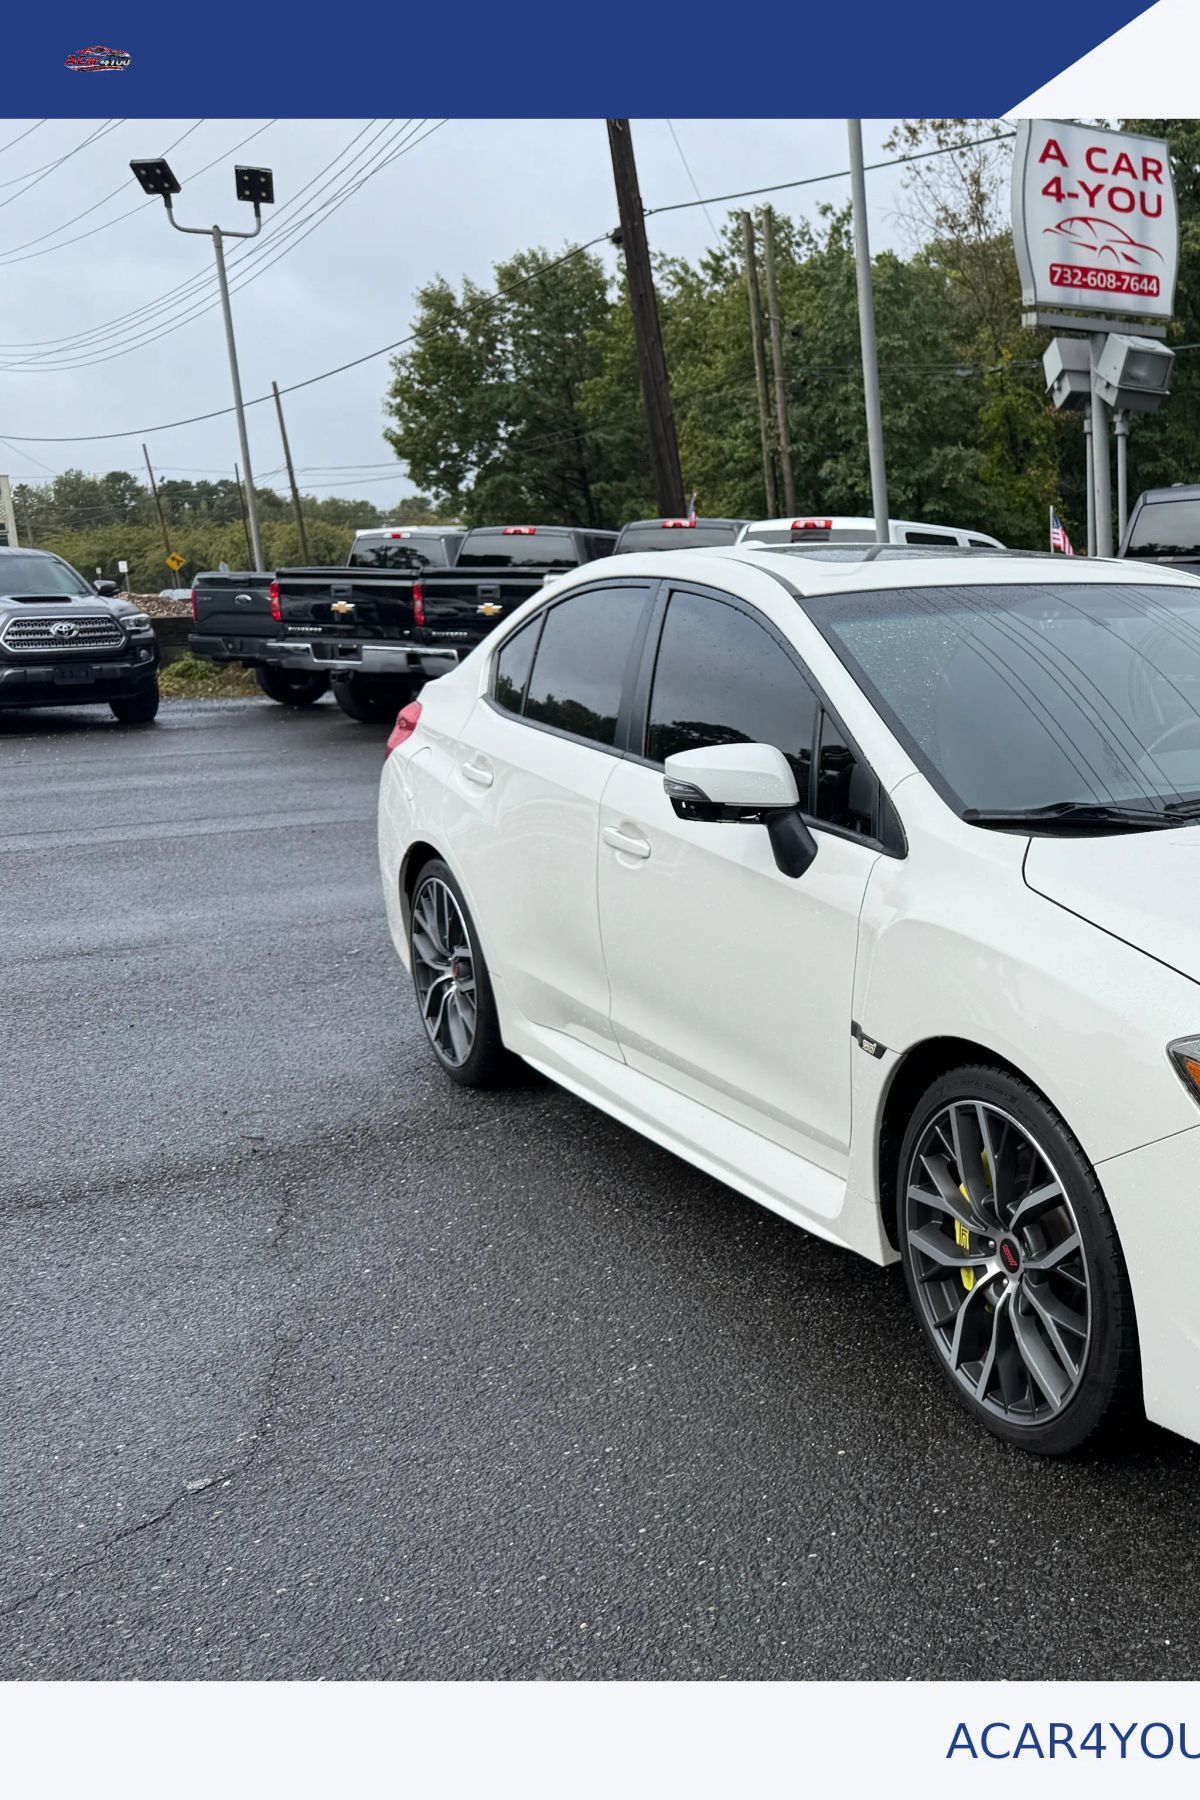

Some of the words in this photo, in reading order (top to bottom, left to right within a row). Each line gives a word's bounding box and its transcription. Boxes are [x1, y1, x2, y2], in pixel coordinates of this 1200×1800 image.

[1038, 138, 1068, 168] A
[1085, 146, 1164, 185] CAR
[1041, 175, 1162, 218] 4-YOU
[1051, 266, 1159, 295] 732-608-7644
